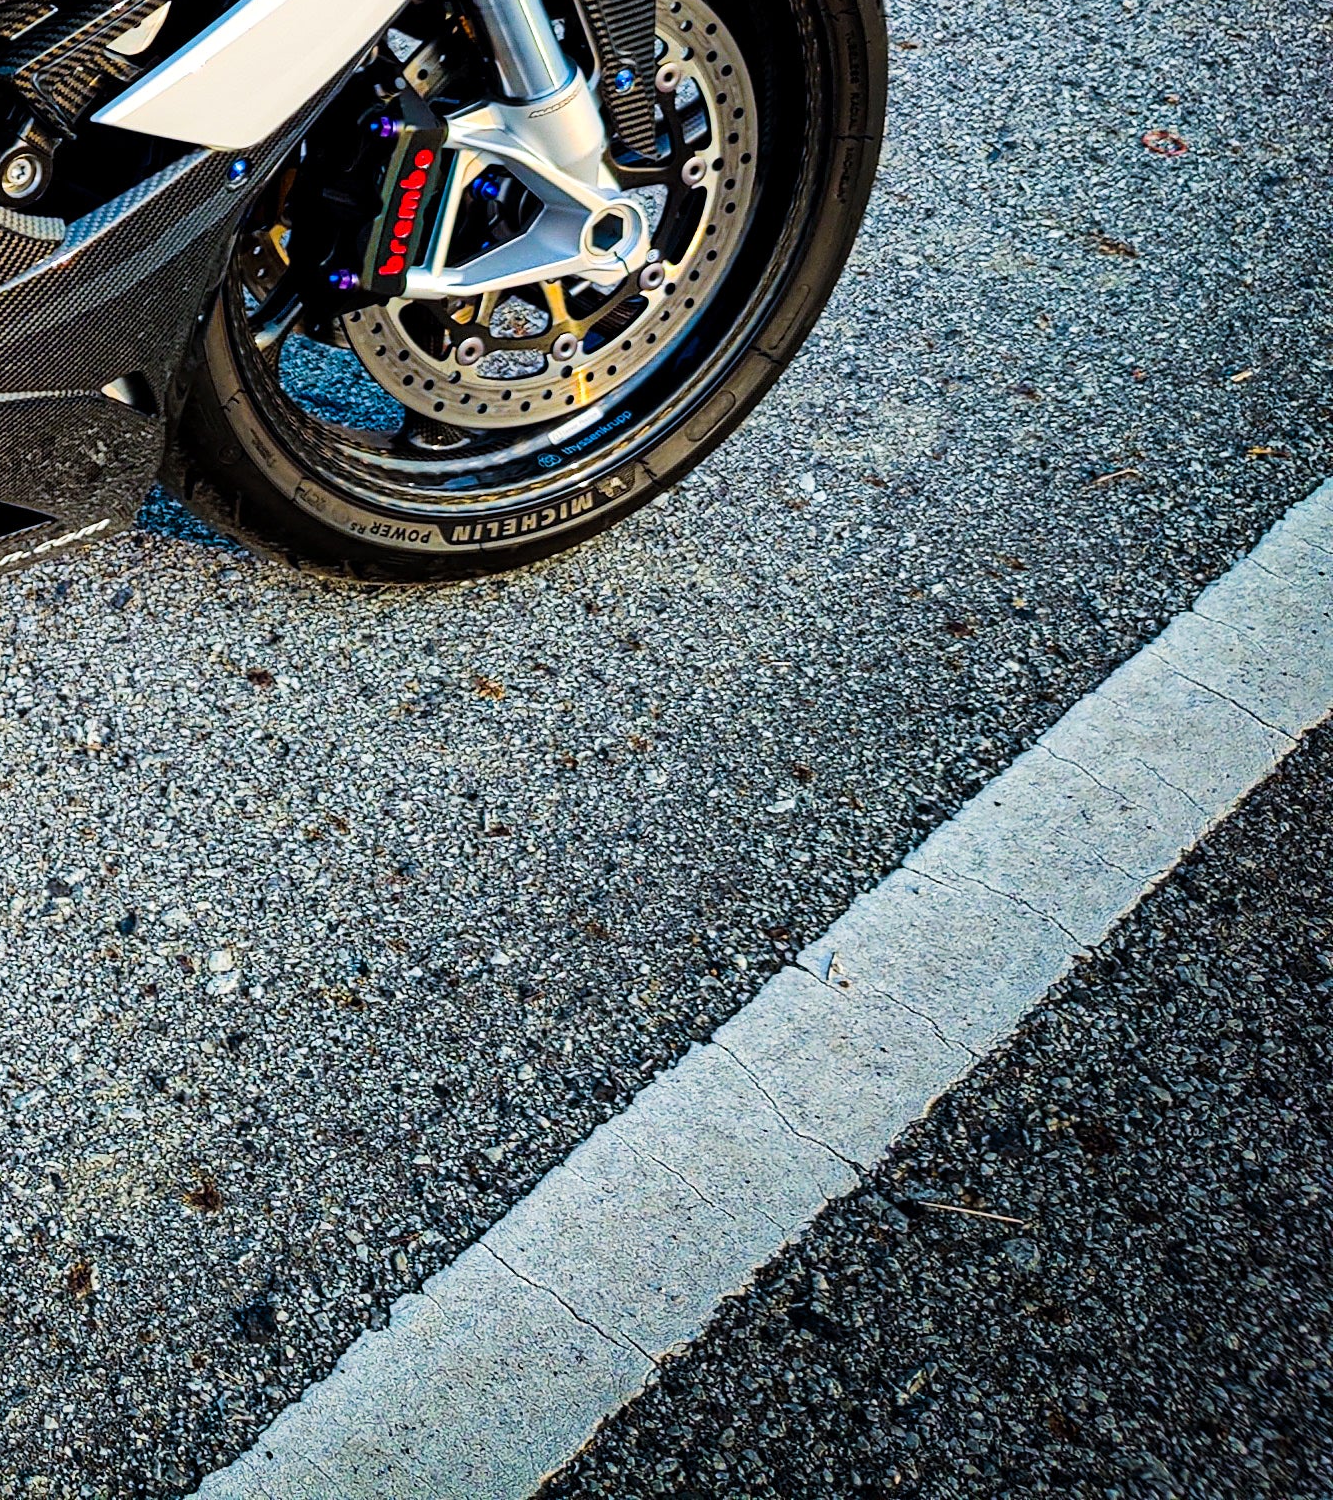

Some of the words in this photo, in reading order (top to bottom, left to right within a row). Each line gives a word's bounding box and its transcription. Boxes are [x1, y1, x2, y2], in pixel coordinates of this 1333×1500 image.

[378, 148, 435, 276] brembo
[560, 409, 633, 456] thyssenkrupp
[370, 519, 432, 546] POWER
[450, 490, 595, 543] MICHELIN
